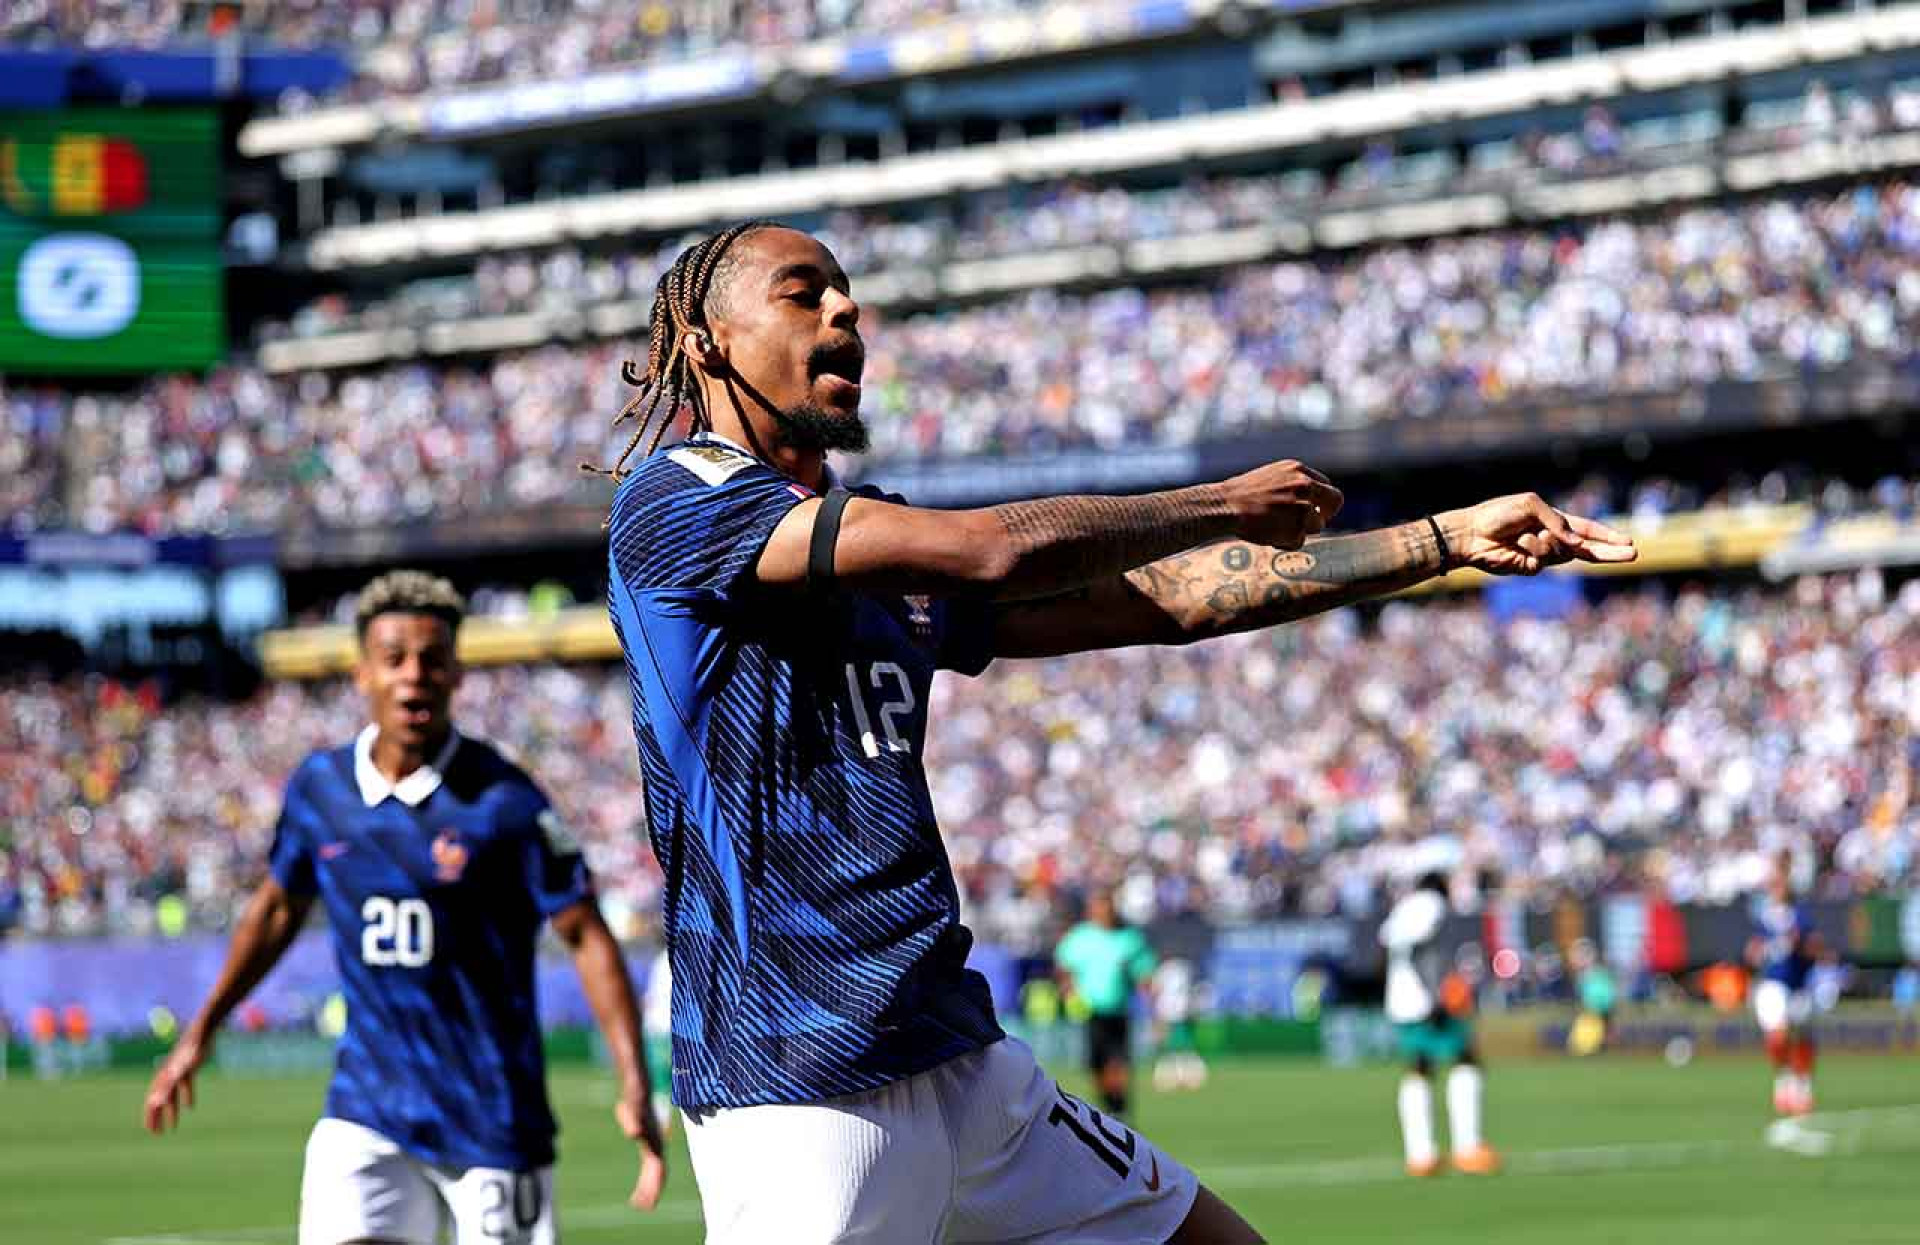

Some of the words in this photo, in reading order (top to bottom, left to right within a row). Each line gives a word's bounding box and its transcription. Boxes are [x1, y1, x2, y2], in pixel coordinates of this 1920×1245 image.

[845, 661, 915, 758] 12
[361, 896, 435, 968] 20
[1048, 1083, 1136, 1180] 12
[479, 1172, 544, 1239] 20
